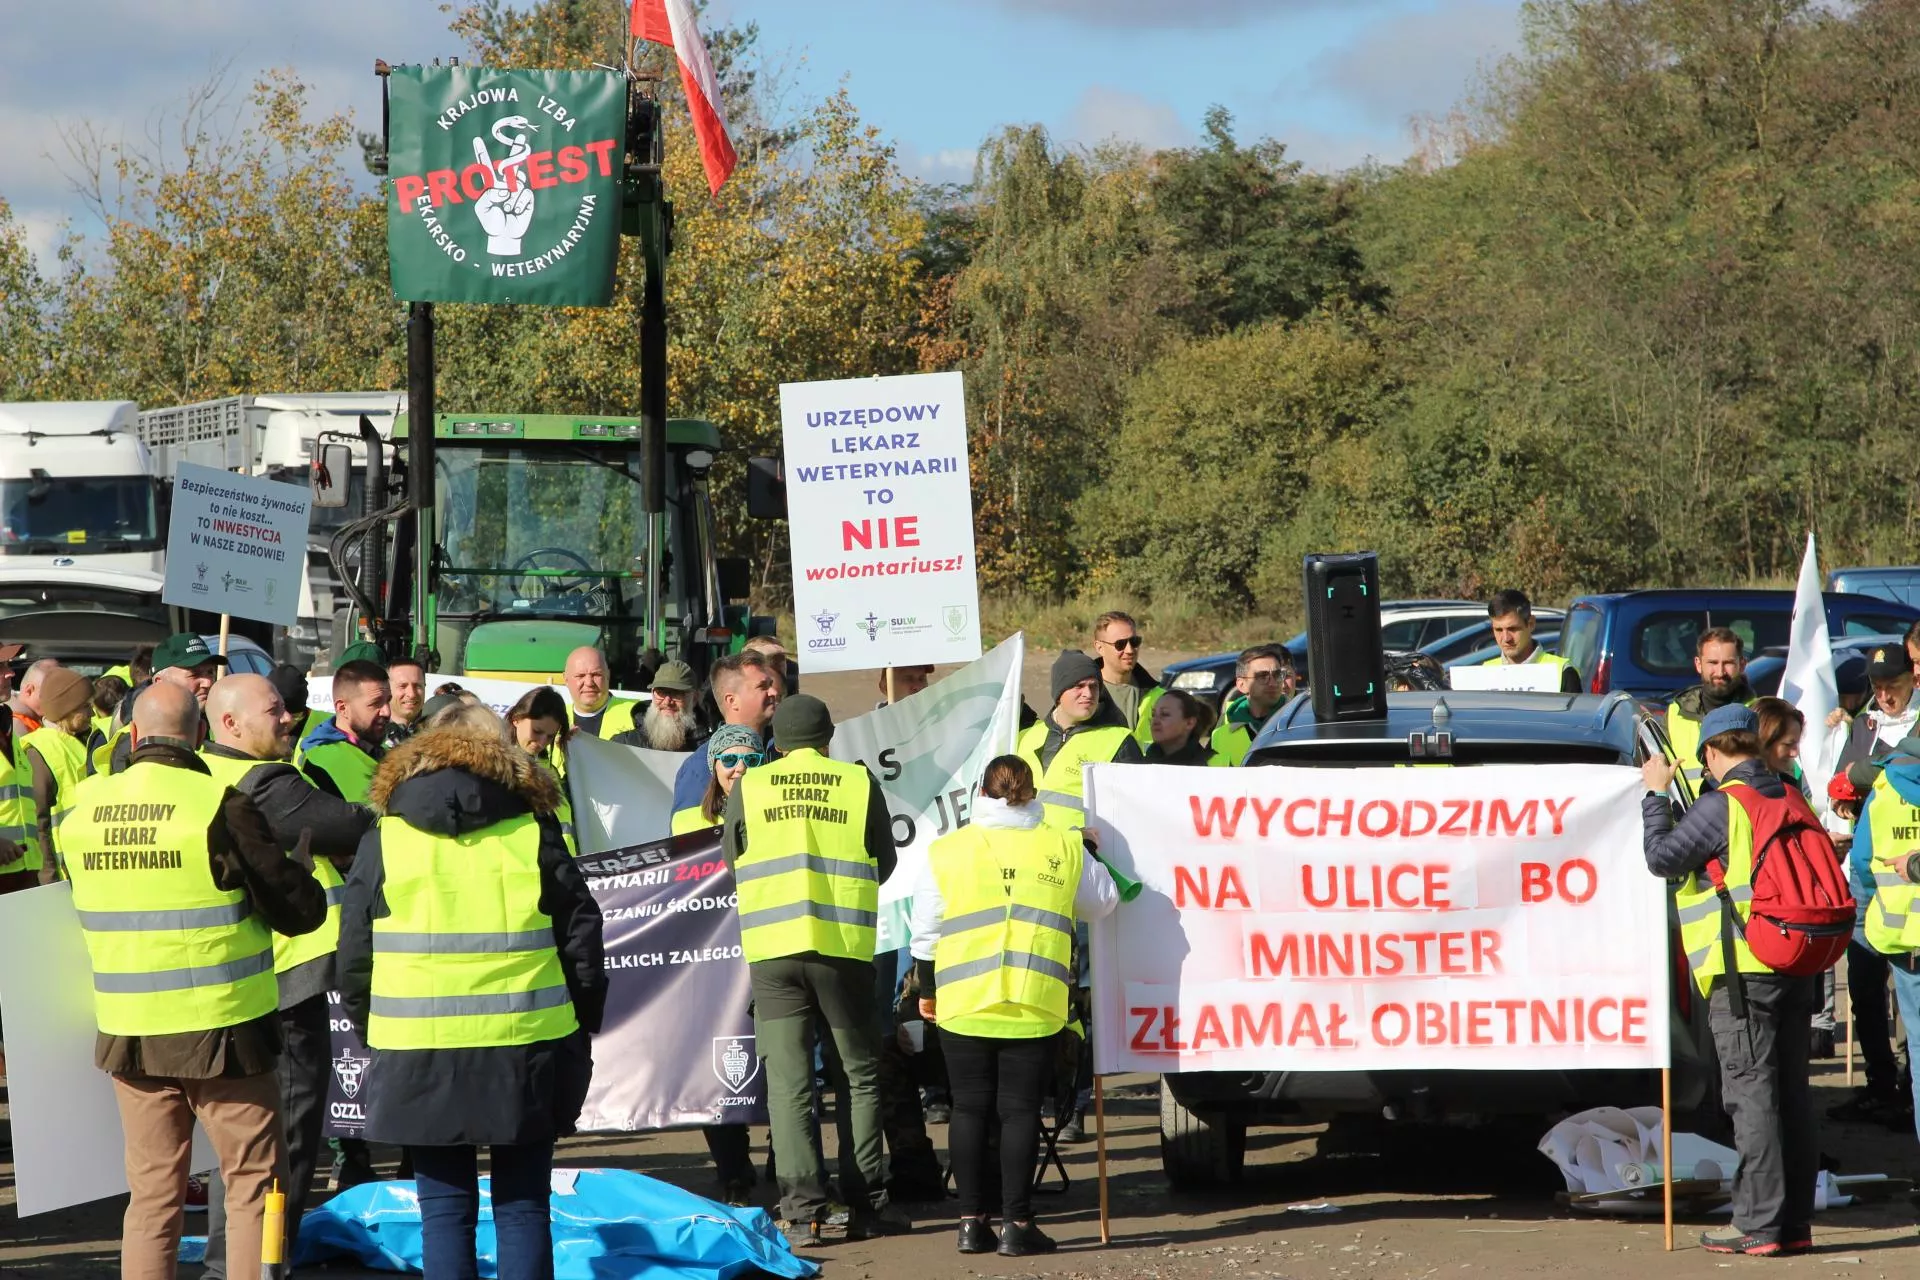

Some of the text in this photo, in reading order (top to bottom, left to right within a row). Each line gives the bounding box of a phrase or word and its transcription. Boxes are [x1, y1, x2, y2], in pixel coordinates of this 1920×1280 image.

[437, 87, 577, 132] KRAJOWA IZBA
[394, 139, 617, 213] PROTEST
[417, 186, 466, 262] EKARSKO
[491, 193, 597, 277] WETERYNARYJNA
[806, 404, 941, 428] URZĘDOWY
[797, 457, 957, 482] WETERYNARII
[181, 479, 306, 515] Bezpieczeństwo żywności
[863, 489, 894, 505] TO
[210, 502, 273, 525] to nie koszt...
[198, 517, 282, 544] TO INWESTYCJA
[841, 516, 920, 551] NIE
[191, 532, 285, 562] W NASZE ZDROWIE!
[806, 555, 963, 581] wolontariusz!
[891, 617, 917, 626] SULW
[808, 637, 846, 648] OZZLW
[771, 772, 843, 787] URZĘDOWY
[782, 788, 830, 803] LEKARZ
[93, 804, 177, 825] URZĘDOWY
[764, 804, 848, 825] WETERYNARII
[1189, 795, 1576, 838] WYCHODZIMY
[104, 827, 157, 846] LEKARZ
[1892, 826, 1920, 840] WET
[83, 850, 182, 870] WETERYNARII
[586, 869, 670, 892] RYNARII
[1038, 872, 1065, 886] OZZLW
[1174, 864, 1251, 910] NA
[1521, 857, 1598, 905] BO
[602, 891, 738, 922] CZANIU ŚRODKÓ
[603, 945, 745, 970] ELKICH ZALEGŁO
[1250, 930, 1504, 976] MINISTER
[1130, 997, 1648, 1050] ZŁAMAŁ OBIETNICE
[330, 1102, 367, 1119] OZZL
[717, 1095, 757, 1107] OZZPIW
